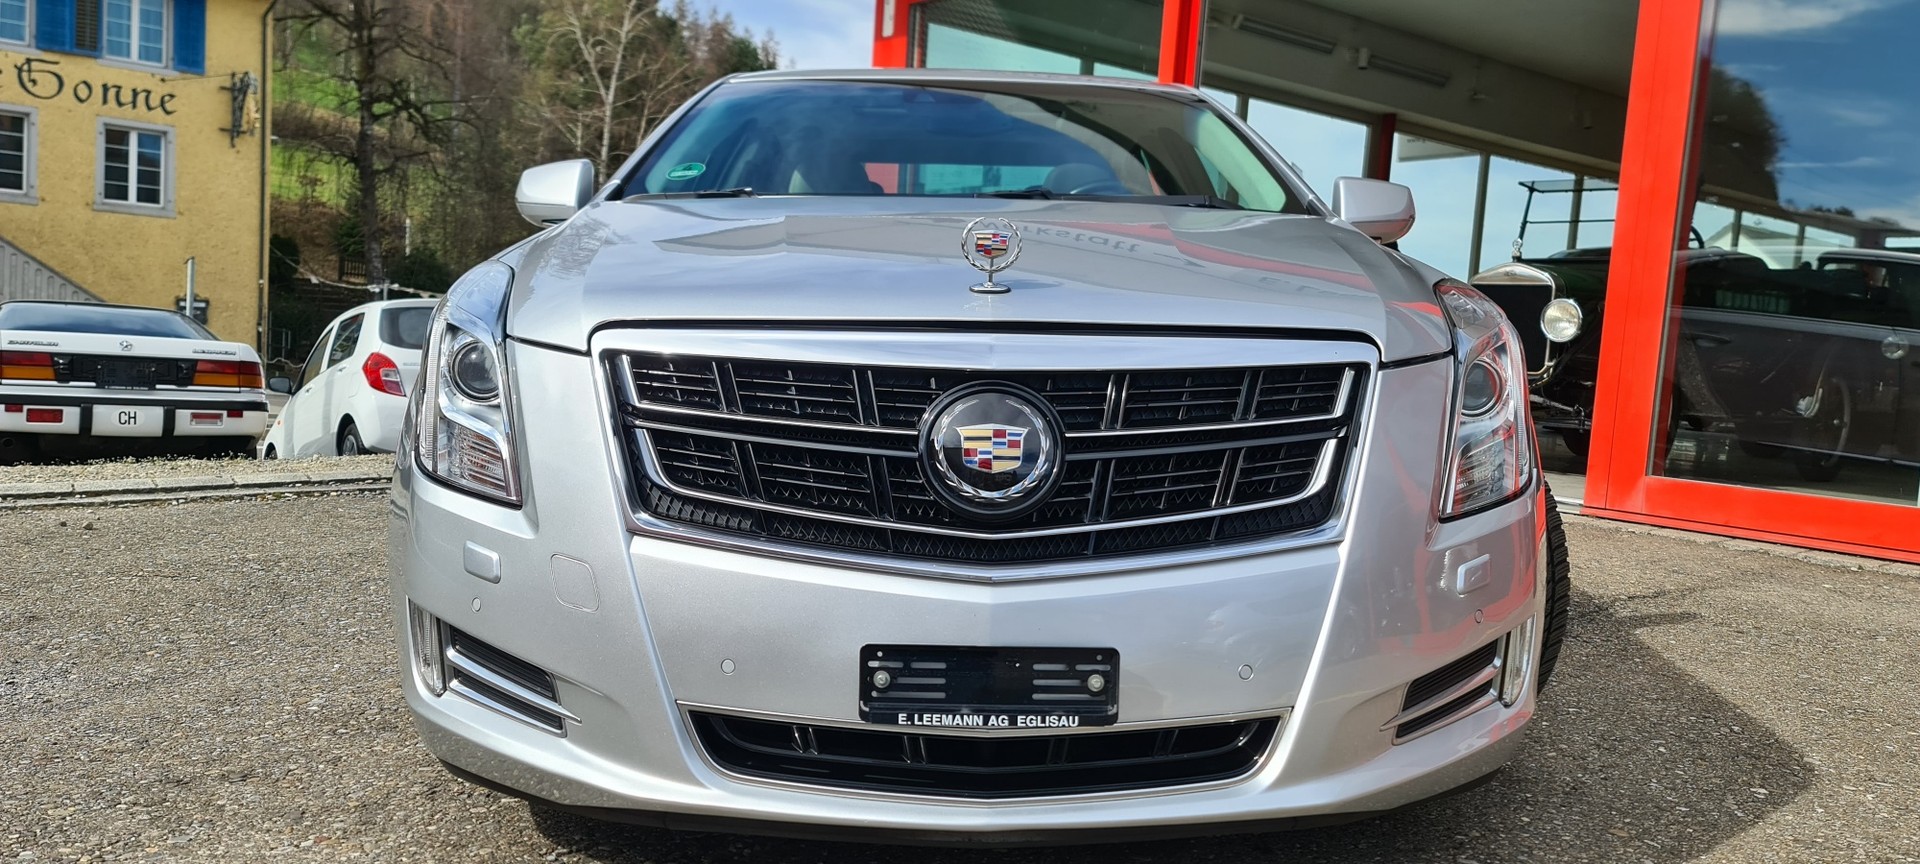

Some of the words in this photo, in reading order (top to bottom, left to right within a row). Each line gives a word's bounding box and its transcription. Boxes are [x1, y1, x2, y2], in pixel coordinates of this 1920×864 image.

[117, 410, 138, 426] CH
[898, 713, 912, 726] E.
[914, 714, 984, 727] LEEMANN
[987, 714, 1010, 727] AG
[1016, 715, 1080, 728] EGLISAU
